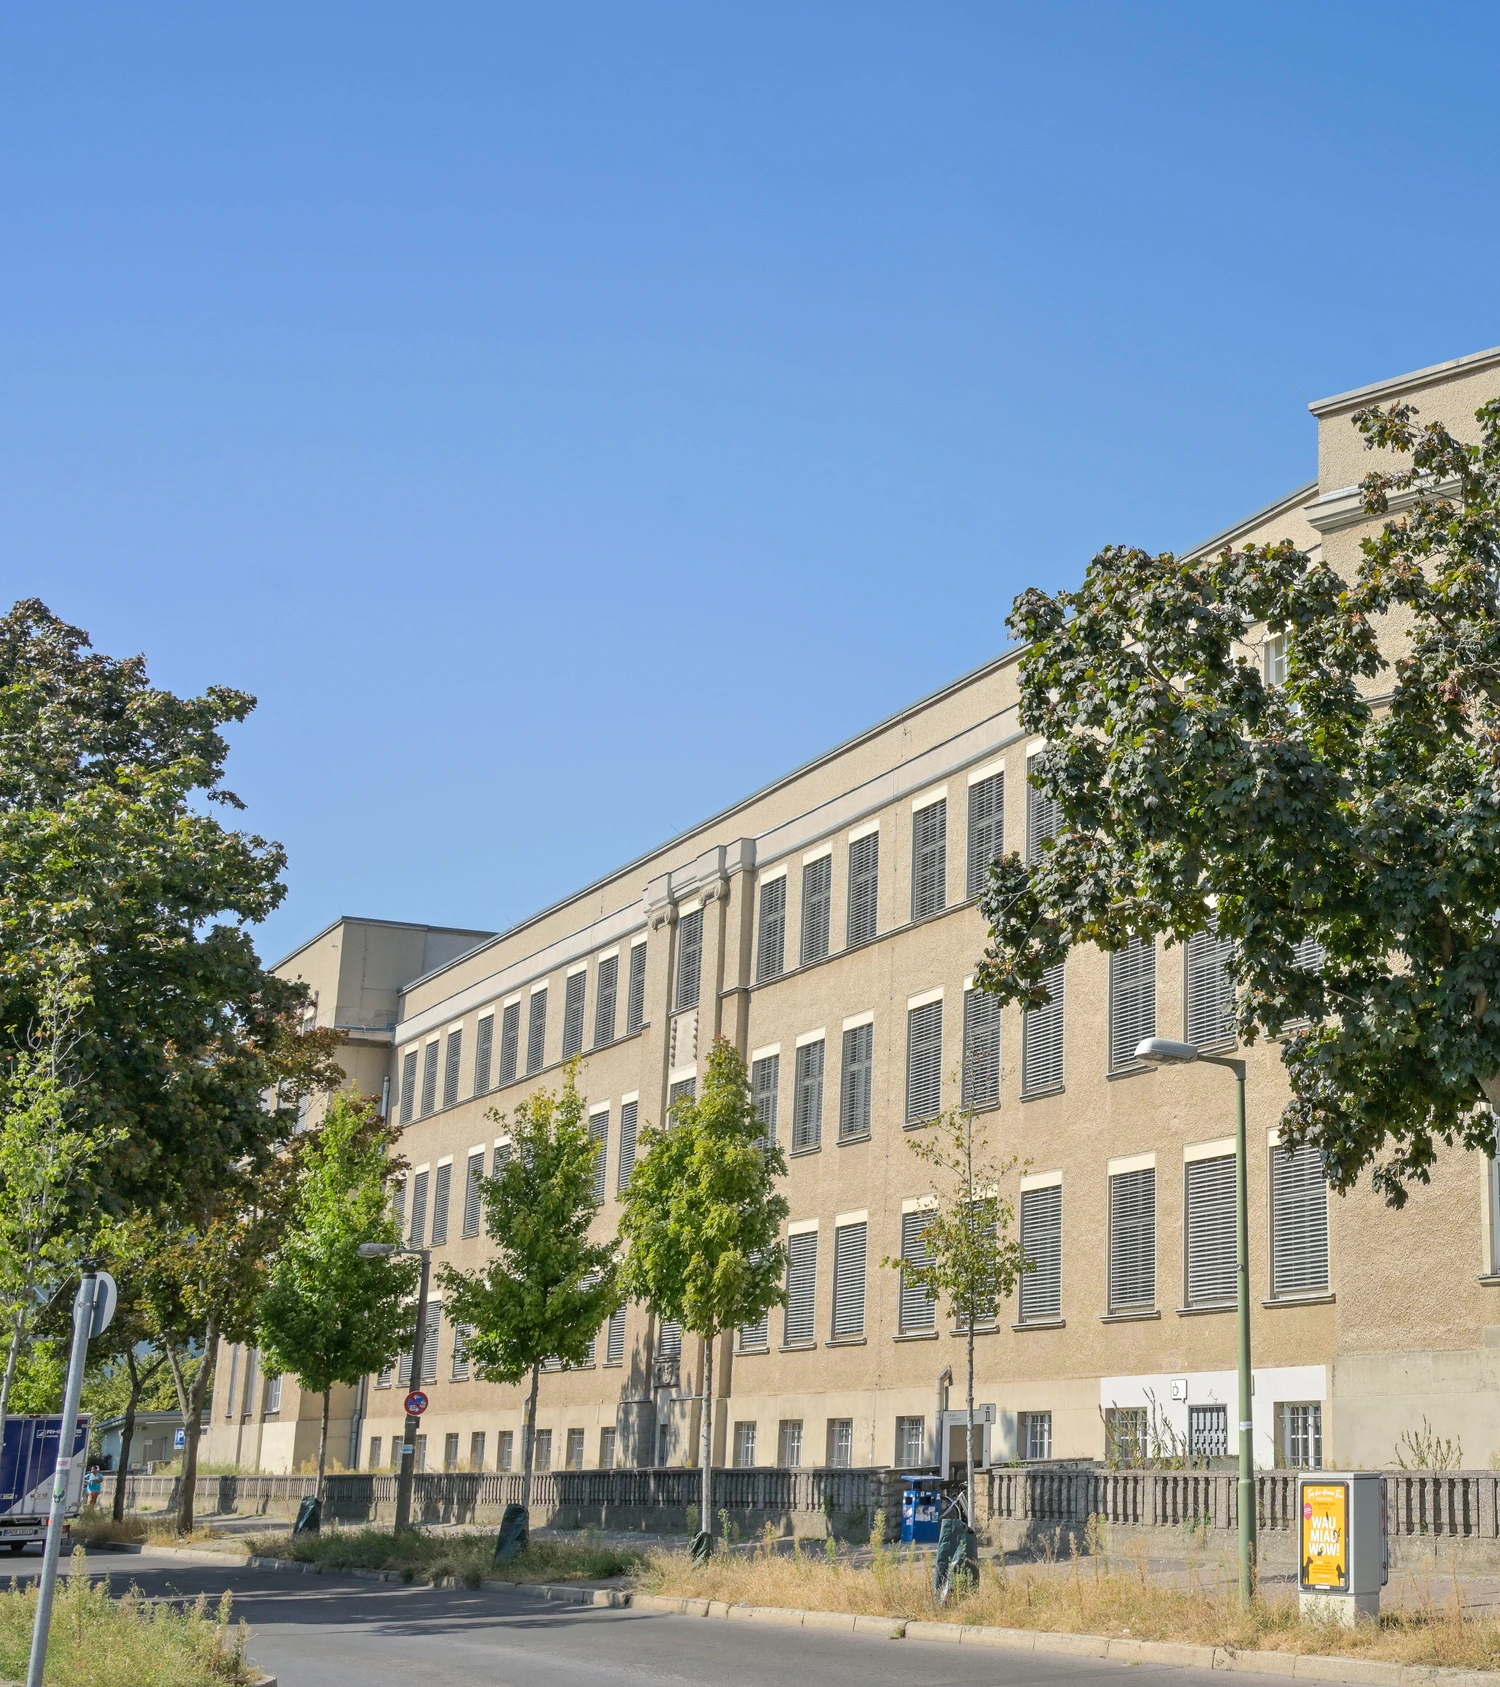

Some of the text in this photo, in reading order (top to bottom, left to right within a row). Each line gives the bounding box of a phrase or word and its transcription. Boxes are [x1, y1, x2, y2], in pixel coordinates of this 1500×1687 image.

[178, 1430, 184, 1442] P
[1311, 1516, 1336, 1529] WAU
[1311, 1529, 1338, 1543] MIAU
[1308, 1542, 1340, 1556] WOW!
